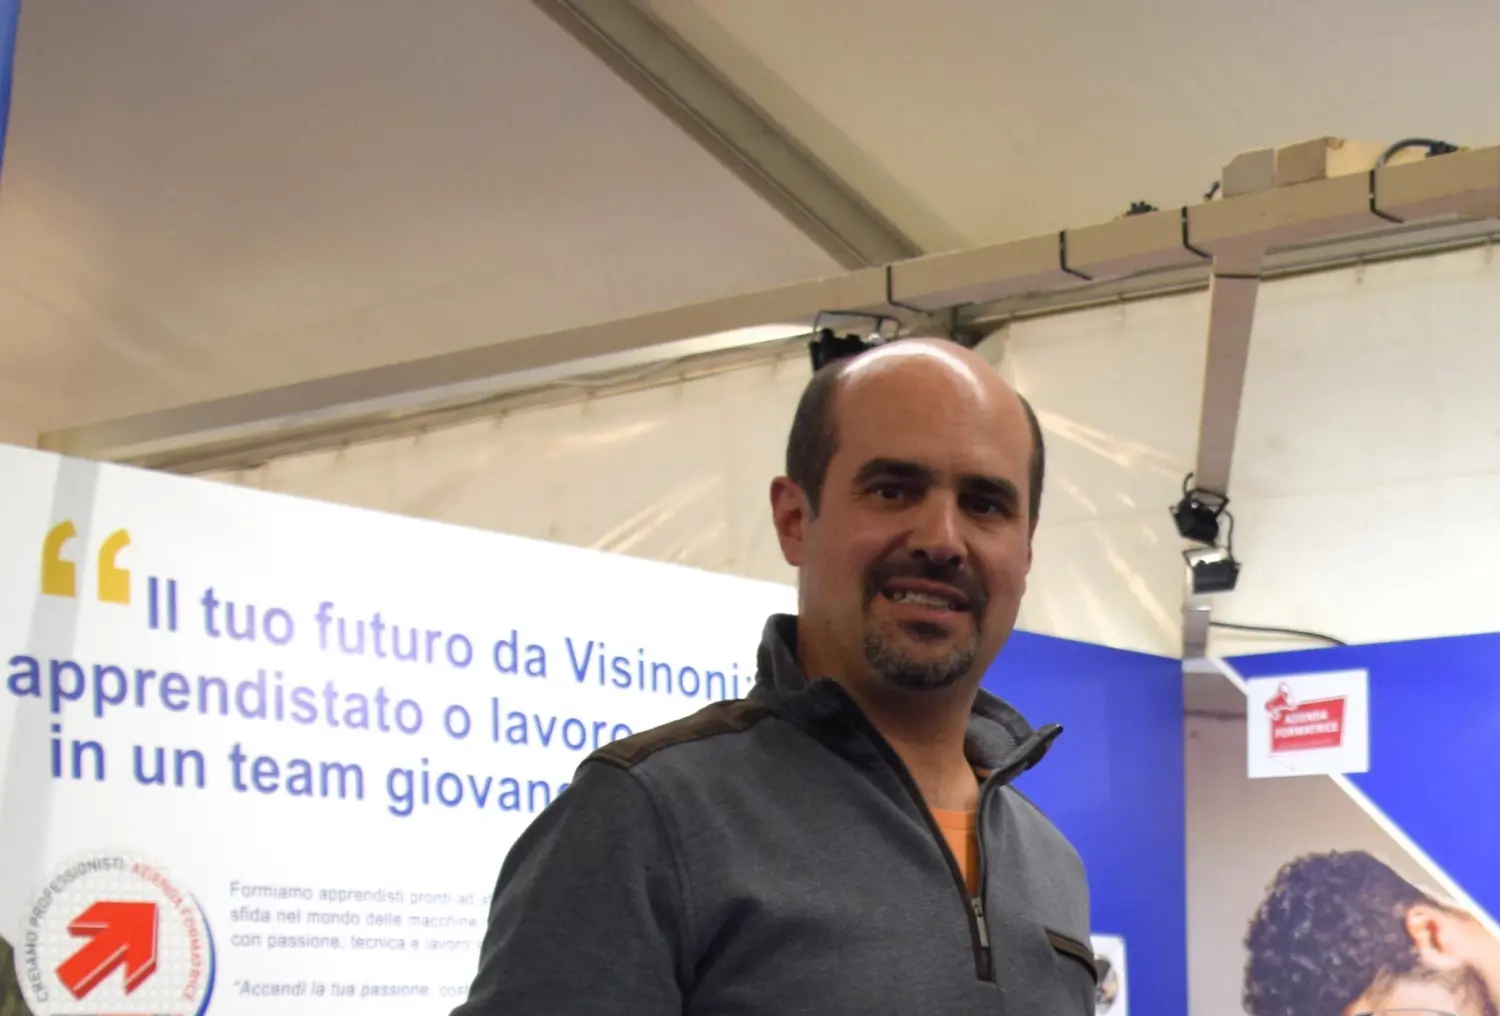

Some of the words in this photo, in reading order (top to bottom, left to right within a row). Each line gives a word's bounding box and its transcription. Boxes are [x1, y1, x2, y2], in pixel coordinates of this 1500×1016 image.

[147, 576, 177, 632] Il
[199, 586, 295, 646] tuo
[314, 601, 474, 668] futuro
[492, 629, 547, 679] da
[6, 654, 424, 735] apprendistato
[443, 703, 471, 740] o
[50, 722, 106, 782] in
[132, 744, 207, 789] un
[228, 741, 365, 801] team
[385, 757, 574, 817] giovan
[229, 881, 313, 901] Formiamo
[319, 887, 405, 905] apprendisti
[230, 907, 271, 923] sfida
[277, 908, 301, 924] nel
[307, 909, 360, 926] mondo
[366, 912, 402, 927] delle
[230, 933, 260, 949] con
[350, 935, 406, 951] tecnica
[331, 981, 355, 998] tua
